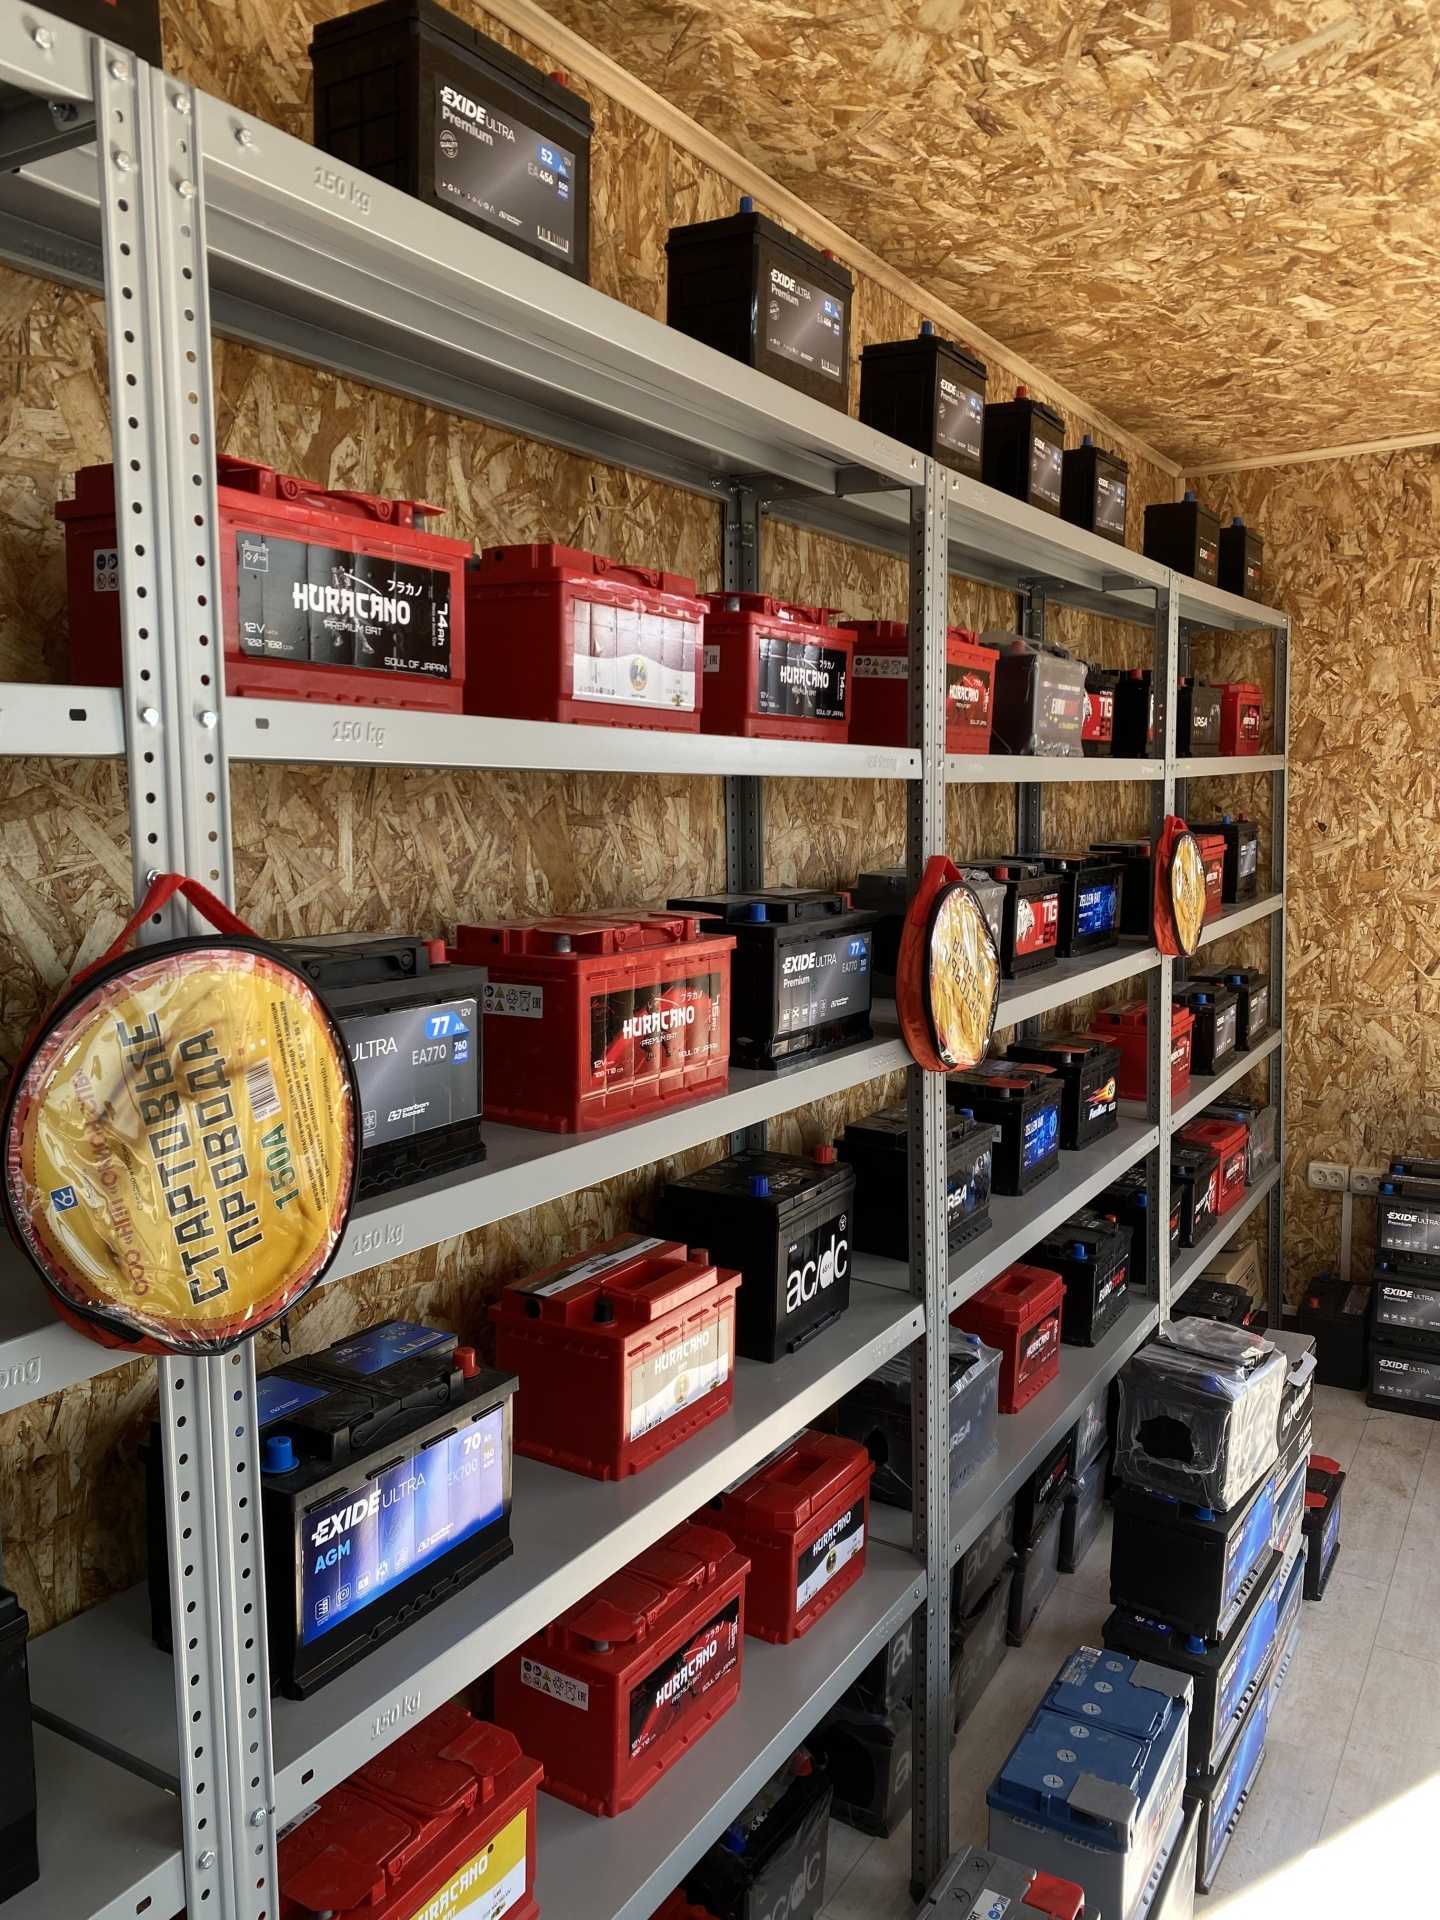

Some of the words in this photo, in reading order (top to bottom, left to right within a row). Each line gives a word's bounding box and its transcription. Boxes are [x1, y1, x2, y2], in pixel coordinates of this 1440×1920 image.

[440, 86, 487, 125] EXIDE
[485, 113, 516, 143] ULTRA
[442, 106, 494, 147] Premium
[541, 147, 554, 164] 52
[313, 166, 345, 199] 150
[349, 183, 373, 215] kg
[770, 268, 796, 292] EXIDE
[771, 283, 800, 306] Premium
[292, 582, 411, 625] HURACANO
[243, 622, 265, 634] 12V
[384, 656, 407, 668] SOUL
[408, 659, 421, 669] OF
[421, 661, 448, 673] JAPAN
[780, 665, 829, 689] HURACANO
[332, 720, 363, 743] 150
[366, 721, 386, 749] kg
[850, 942, 860, 955] 77
[782, 952, 816, 974] EXIDE
[815, 953, 837, 968] ULTRA
[842, 959, 858, 973] EA770
[783, 975, 810, 988] Premium
[460, 1007, 472, 1017] 12V
[622, 1004, 696, 1040] HURACANO
[431, 1015, 450, 1037] 77
[411, 1044, 448, 1066] EA770
[454, 1039, 468, 1052] 760
[401, 1101, 431, 1113] carbon
[401, 1109, 426, 1118] boost
[173, 1026, 267, 1255] ПРОВОДА
[117, 1011, 228, 1304] СТАРТОВЫЕ
[947, 1184, 967, 1212] RSA
[1386, 1211, 1419, 1223] EXIDE
[352, 1229, 381, 1257] 150
[385, 1223, 405, 1247] kg
[124, 1249, 149, 1297] ООО
[786, 1233, 848, 1314] ac/dc
[1382, 1287, 1414, 1298] EXIDE
[654, 1331, 711, 1376] HURACANO
[1378, 1359, 1410, 1371] EXIDE
[1409, 1366, 1431, 1376] ULTRA
[463, 1431, 482, 1457] 70
[311, 1489, 382, 1548] EXIDE
[382, 1472, 426, 1509] ULTRA
[812, 1511, 852, 1557] HURACANO
[314, 1538, 351, 1574] AGM
[656, 1639, 718, 1709] HURACANO
